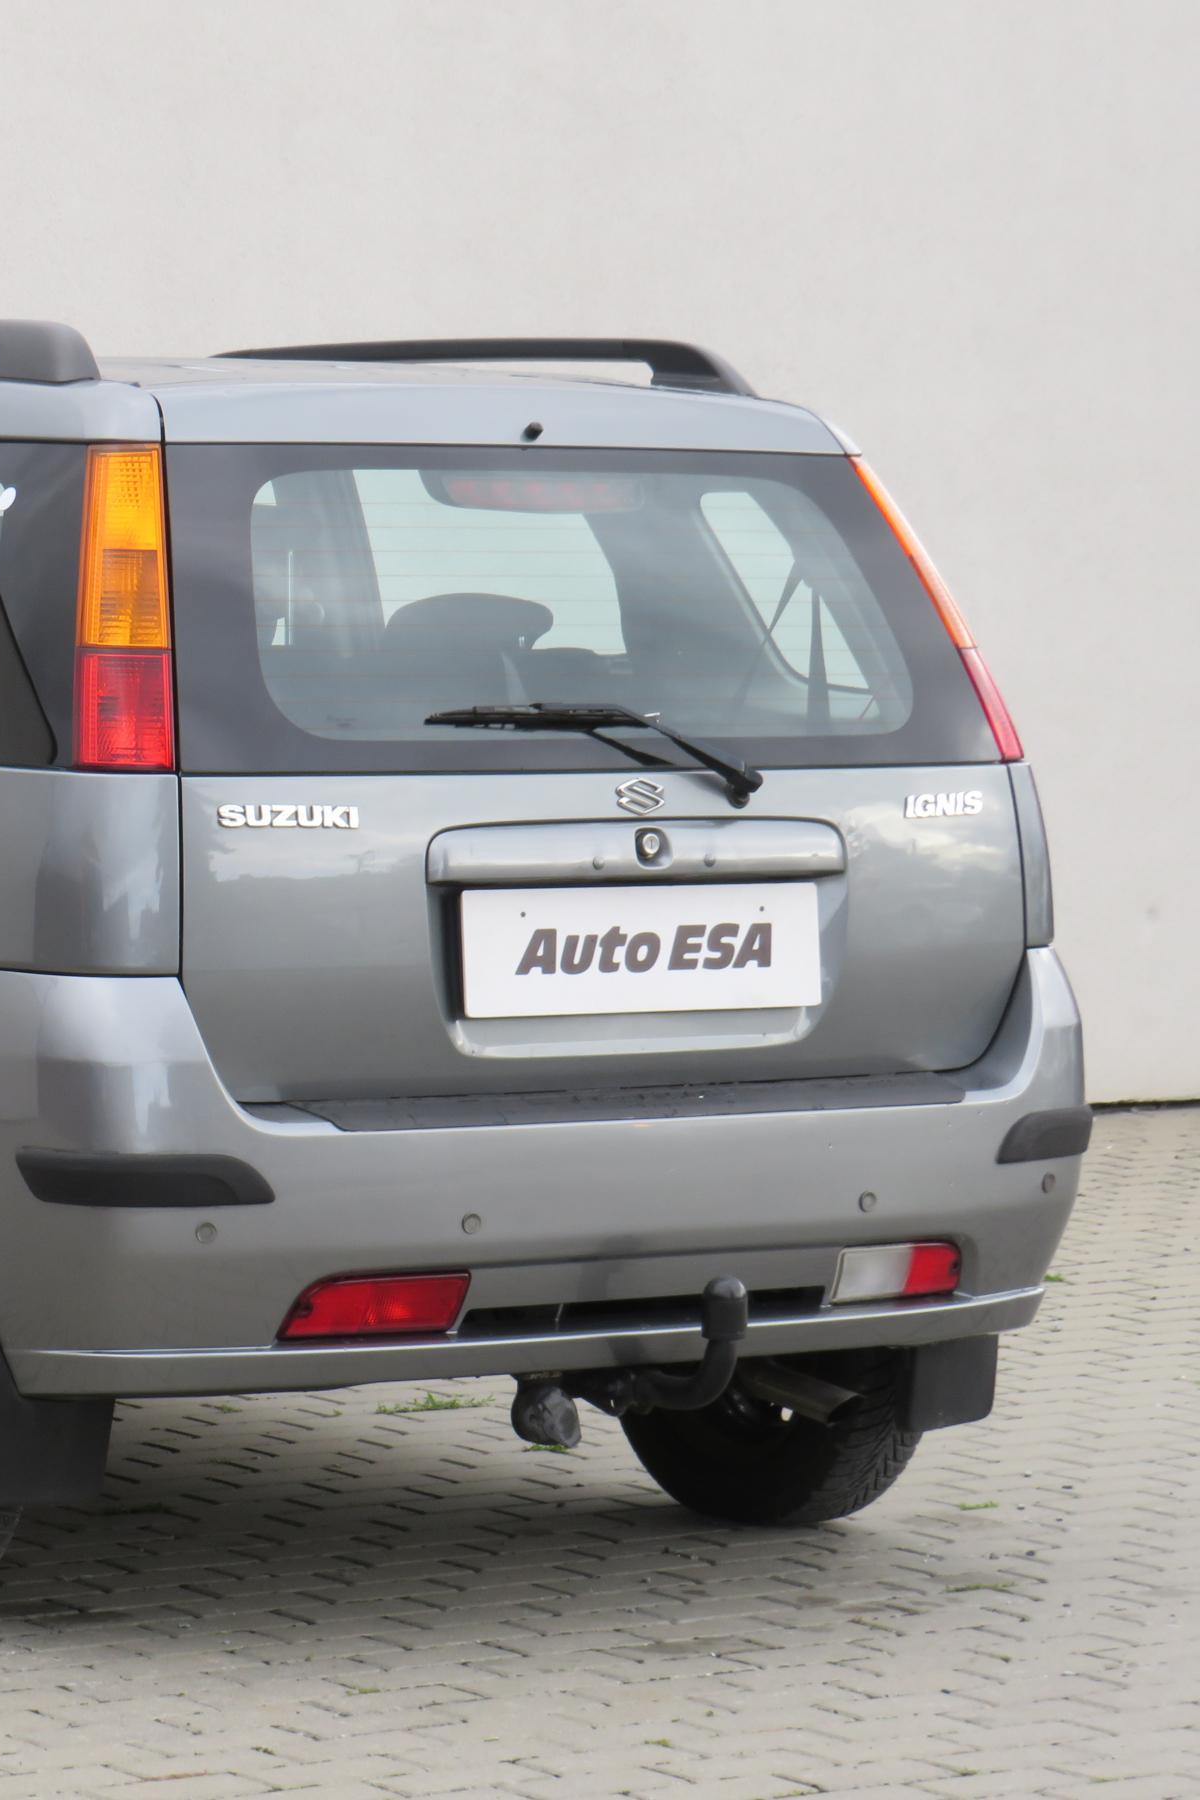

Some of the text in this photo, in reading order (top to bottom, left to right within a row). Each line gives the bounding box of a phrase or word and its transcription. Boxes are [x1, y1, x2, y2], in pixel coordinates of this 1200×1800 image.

[217, 804, 360, 829] SUZUKI
[903, 790, 983, 819] IGNIS
[515, 922, 773, 976] Auto ESA
